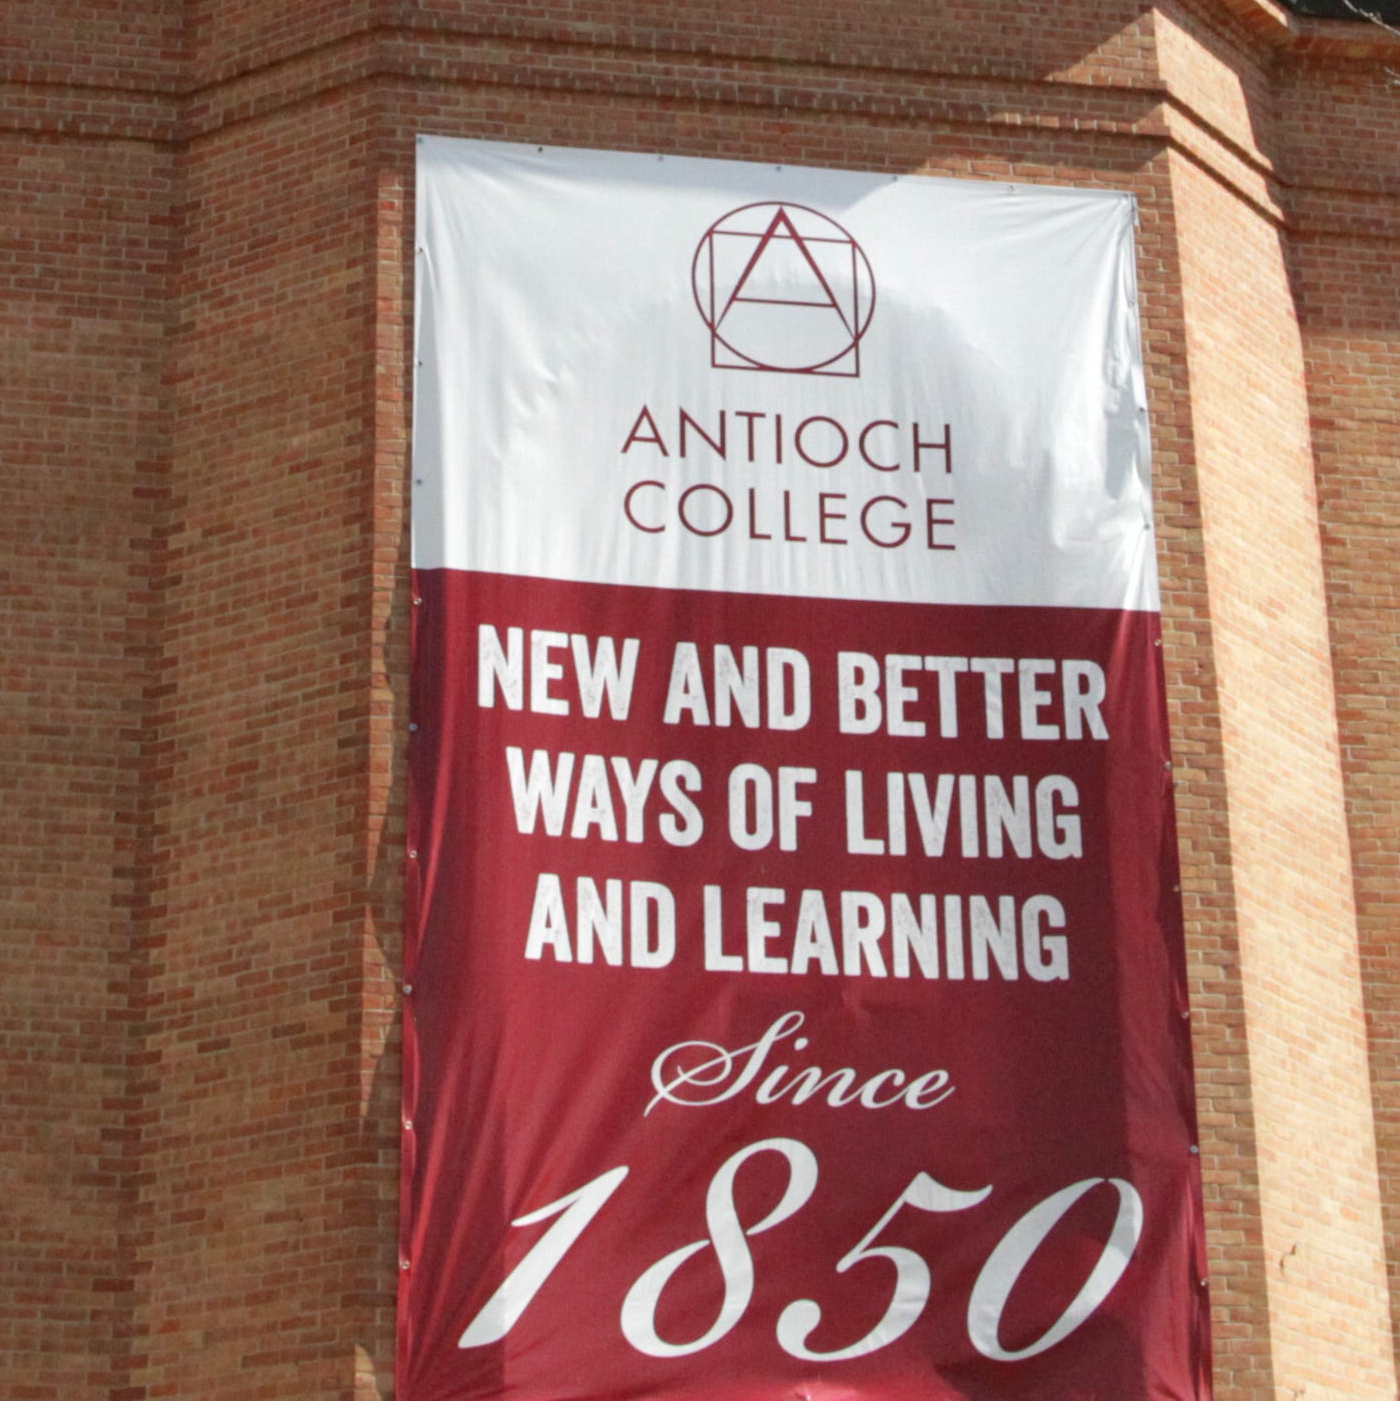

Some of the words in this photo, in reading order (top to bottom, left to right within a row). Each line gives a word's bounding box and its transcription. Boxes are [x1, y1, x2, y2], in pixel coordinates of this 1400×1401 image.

[621, 404, 952, 473] ANTIOCH
[624, 480, 955, 550] COLLEGE
[478, 624, 641, 721] NEW
[663, 641, 811, 731] AND
[837, 651, 1110, 740] BETTER
[505, 746, 704, 847] WAYS
[728, 763, 817, 851] OF
[845, 769, 1083, 860] LIVING
[524, 873, 676, 968] AND
[703, 885, 1070, 982] LEARNING
[644, 1011, 955, 1116] Since
[458, 1137, 1144, 1361] 1850
